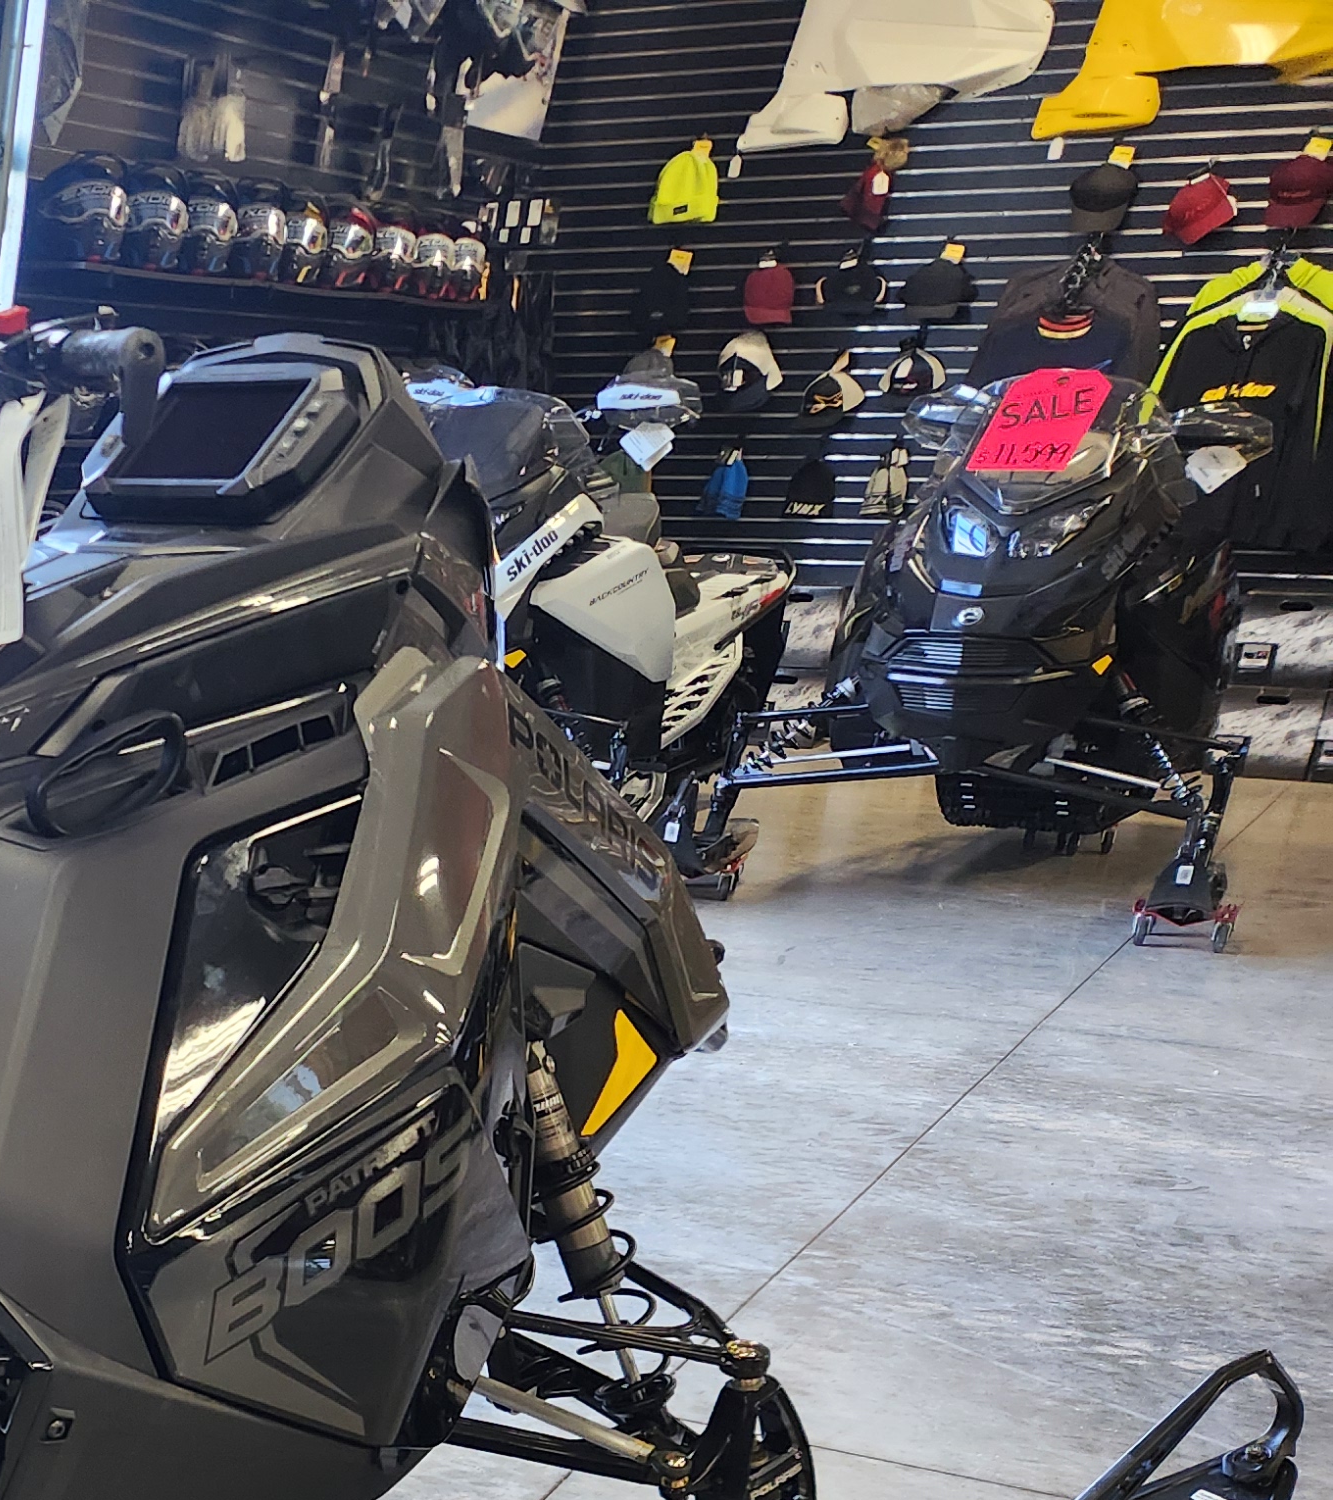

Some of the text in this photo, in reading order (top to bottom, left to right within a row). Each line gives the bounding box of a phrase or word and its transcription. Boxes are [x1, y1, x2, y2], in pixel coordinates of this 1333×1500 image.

[998, 386, 1095, 430] SALE
[784, 501, 826, 516] LYNX
[505, 528, 560, 583] ski-doo
[589, 567, 650, 607] BACKCOUNTRY
[507, 702, 667, 891] POLARIS
